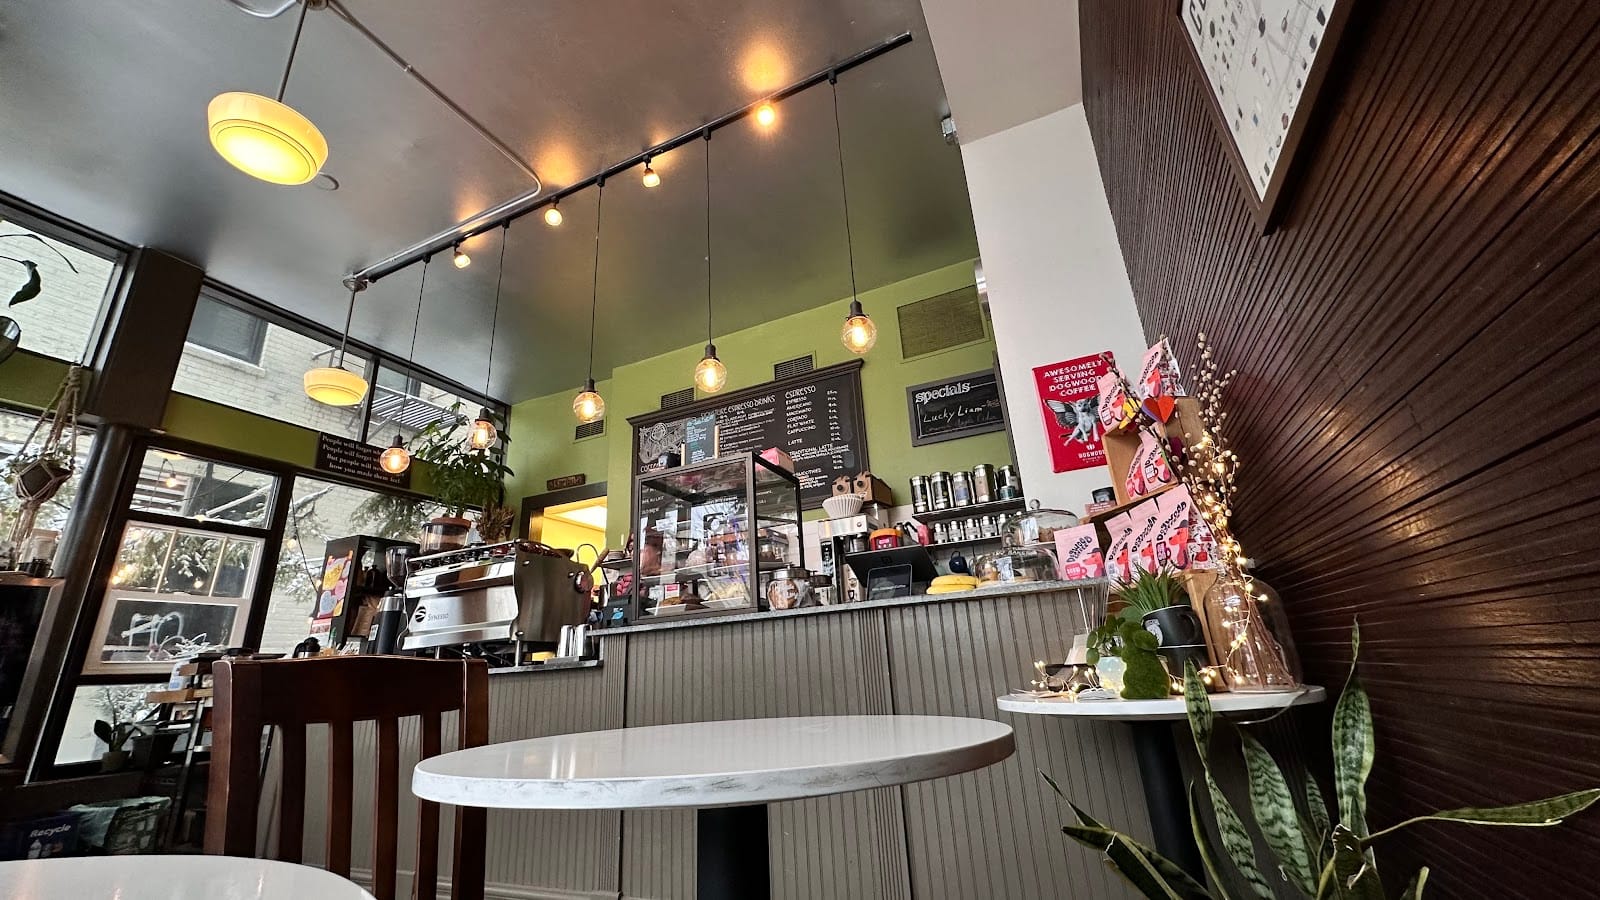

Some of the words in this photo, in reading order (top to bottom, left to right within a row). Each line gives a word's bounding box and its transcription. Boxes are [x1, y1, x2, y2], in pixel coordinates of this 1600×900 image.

[1044, 360, 1102, 377] AWESOMELY
[1054, 369, 1096, 383] SERVING
[785, 385, 816, 399] ESPRESSO
[1049, 375, 1102, 392] DOGWOOD
[1060, 384, 1096, 397] COFFEE
[785, 396, 807, 406] ESPRESSO
[915, 382, 970, 405] specials
[727, 400, 754, 413] ESPRESSO
[754, 394, 776, 407] DRINKS
[923, 408, 955, 423] Lucky
[957, 405, 983, 417] Liam
[322, 435, 343, 446] People
[343, 441, 355, 449] will
[355, 443, 372, 453] forget
[787, 438, 803, 446] LATTE
[322, 444, 344, 455] People
[355, 452, 372, 462] forget
[326, 453, 338, 461] But
[339, 458, 360, 467] people
[329, 462, 342, 470] how
[356, 470, 373, 478] made
[373, 473, 389, 481] them
[1157, 501, 1187, 541] DOGWOOD
[1066, 535, 1093, 563] DOGWOOD
[30, 823, 72, 838] Recycle
